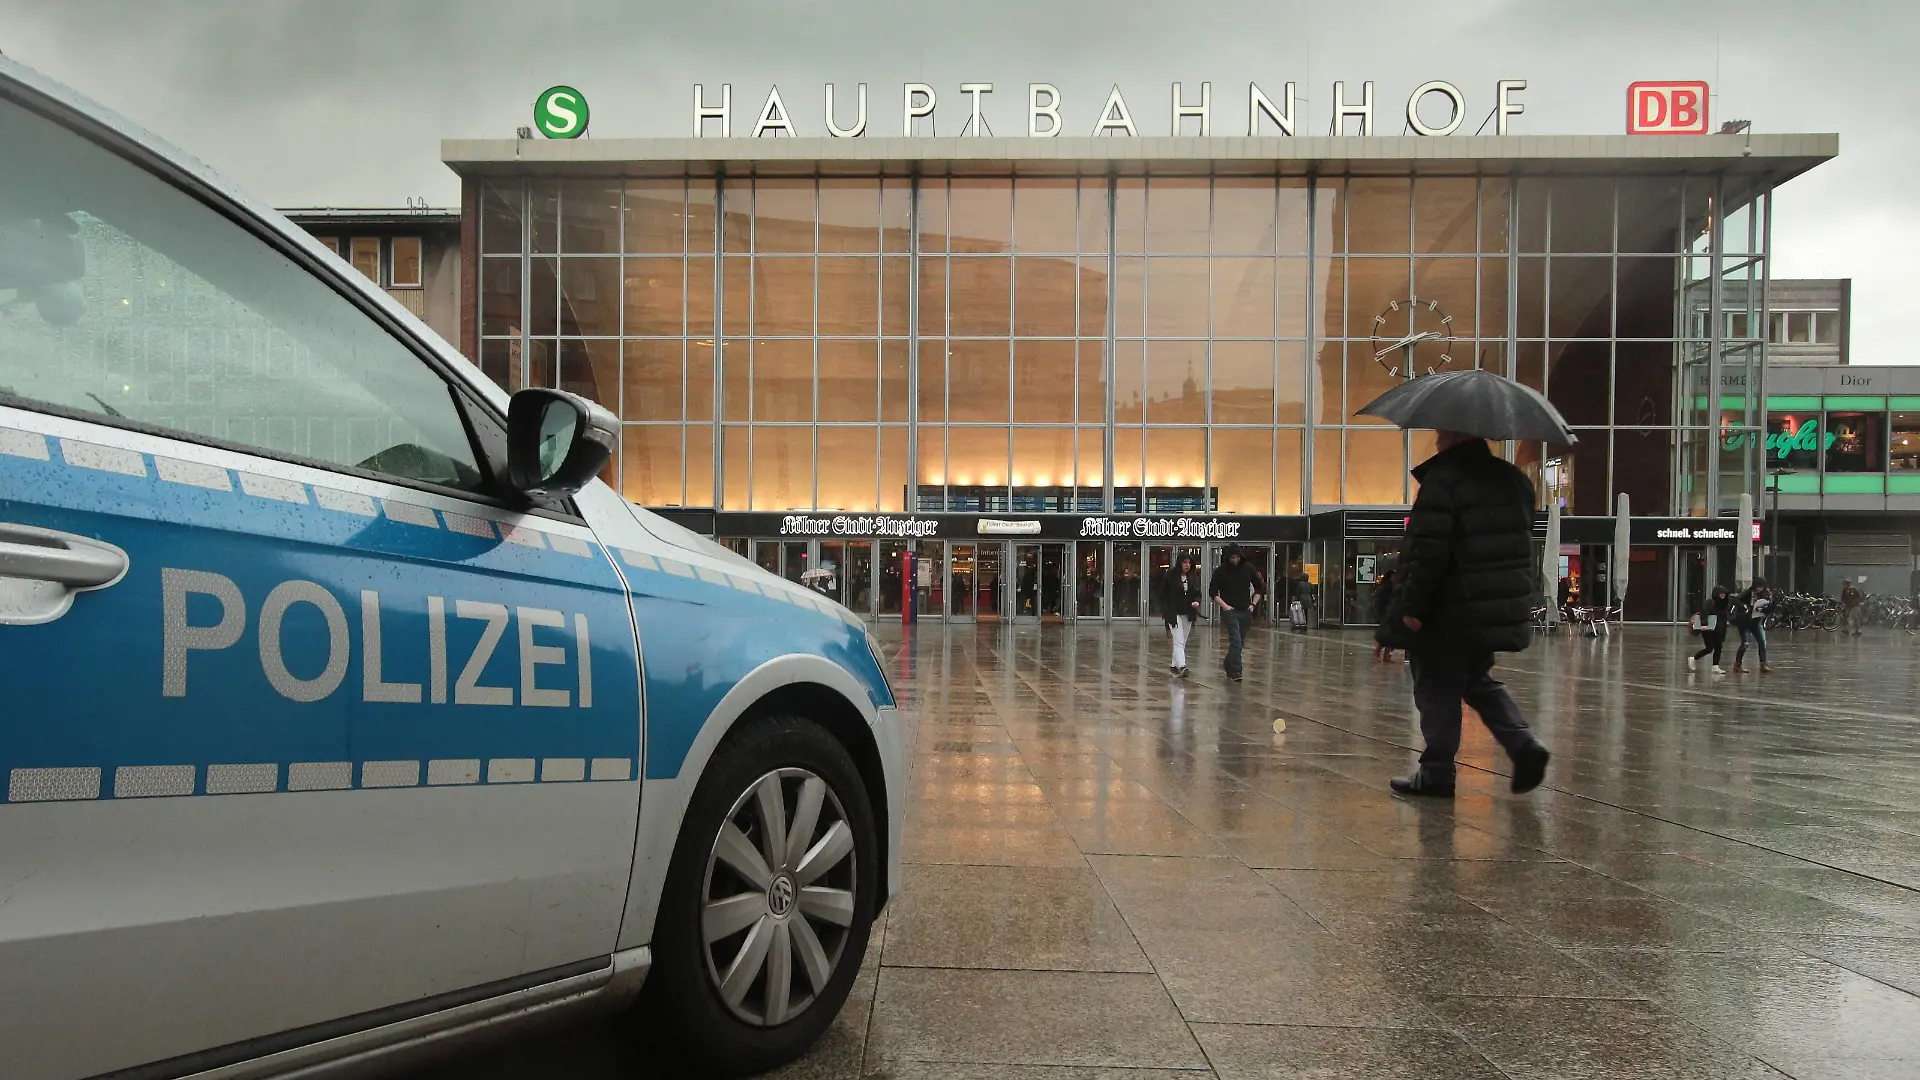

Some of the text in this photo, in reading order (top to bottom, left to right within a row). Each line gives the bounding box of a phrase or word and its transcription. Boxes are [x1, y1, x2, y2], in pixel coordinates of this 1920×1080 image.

[544, 91, 577, 134] S
[693, 79, 1527, 138] HAUPTBAHNHOF
[1638, 90, 1698, 127] DB
[1840, 374, 1872, 386] Dior
[780, 515, 938, 537] Kölner Stadt-Anzeiger
[1080, 517, 1241, 539] Kölner Stadt-Anzeiger
[1656, 527, 1735, 539] schnell. schneller.
[161, 567, 593, 708] POLIZEI
